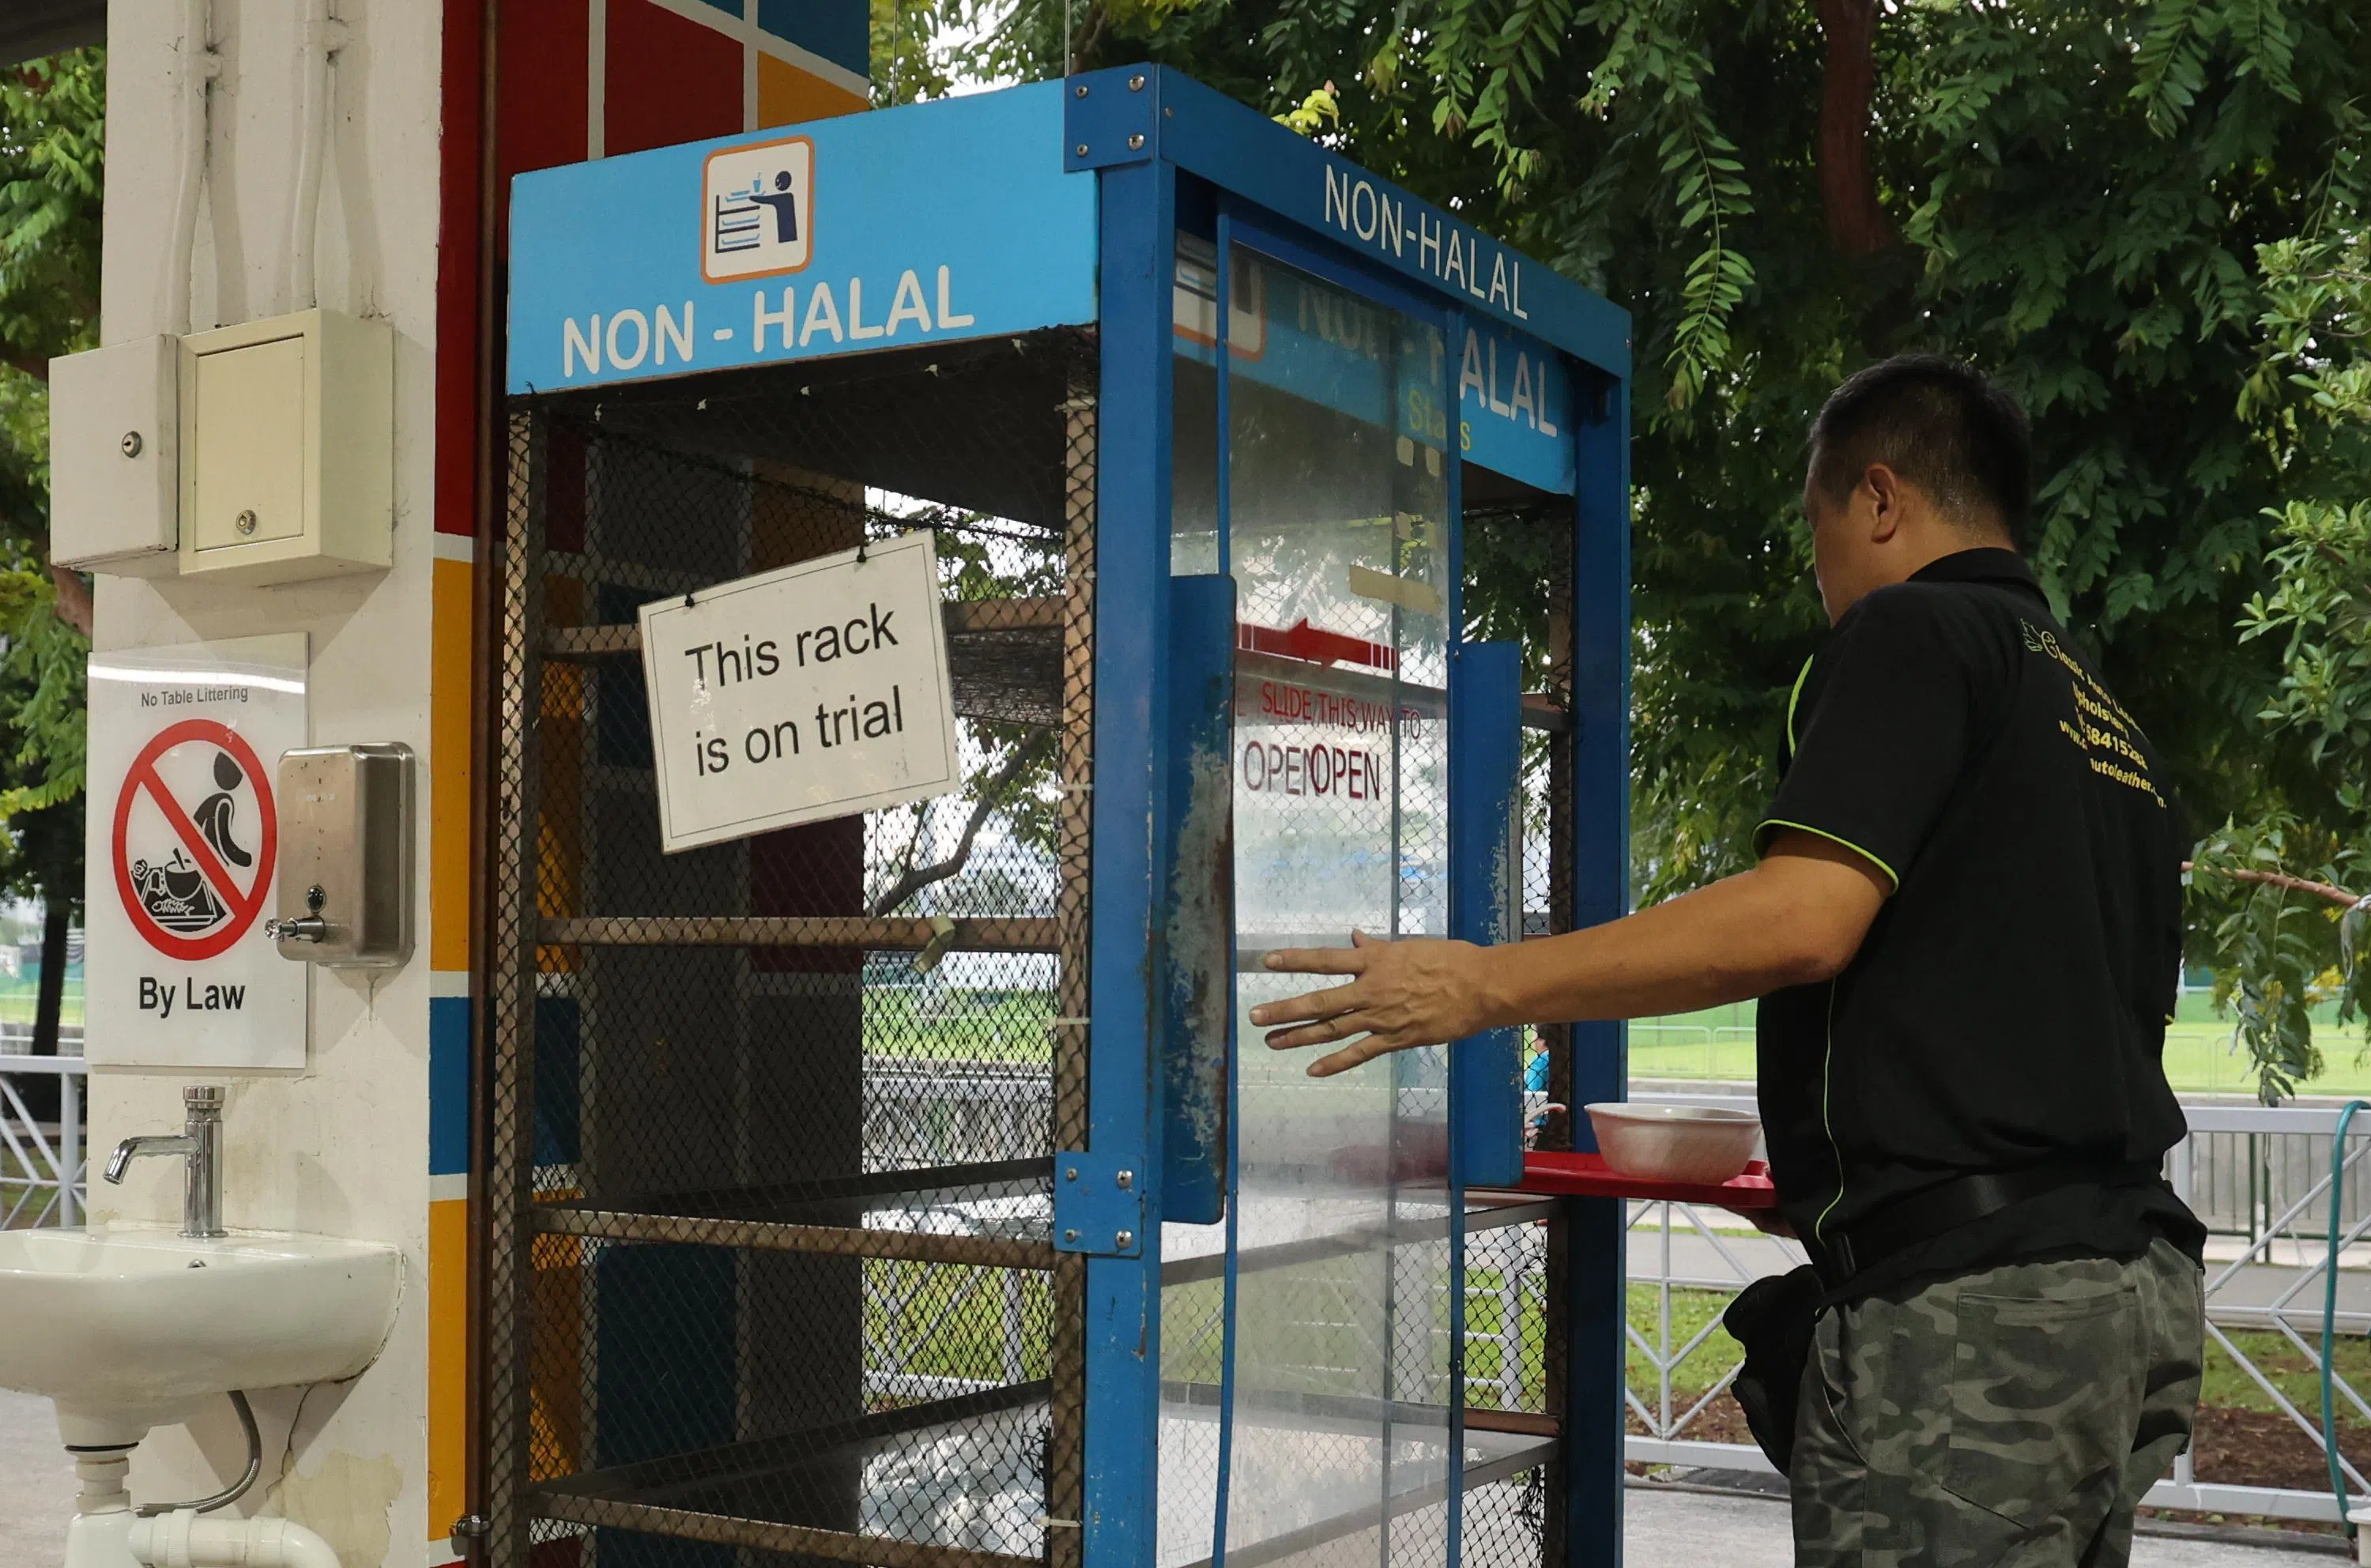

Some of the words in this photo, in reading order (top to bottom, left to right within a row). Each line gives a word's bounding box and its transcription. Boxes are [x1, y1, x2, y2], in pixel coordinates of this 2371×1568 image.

[1325, 164, 1528, 320] NON-HALAL
[562, 300, 694, 378] NON
[753, 264, 974, 352] HALAL
[684, 635, 780, 692] This
[796, 602, 899, 667] rack
[141, 692, 157, 707] No
[161, 689, 193, 706] Table
[196, 685, 249, 703] Littering
[695, 731, 729, 776] is
[745, 719, 799, 764] on
[815, 684, 903, 748] trial
[1261, 681, 1312, 722] SLIDE
[1317, 692, 1356, 729] THIS
[1361, 702, 1394, 735] WAY
[1401, 707, 1421, 740] TO
[1311, 743, 1380, 801] OPEN
[139, 977, 175, 1019] By
[186, 976, 246, 1011] Law
